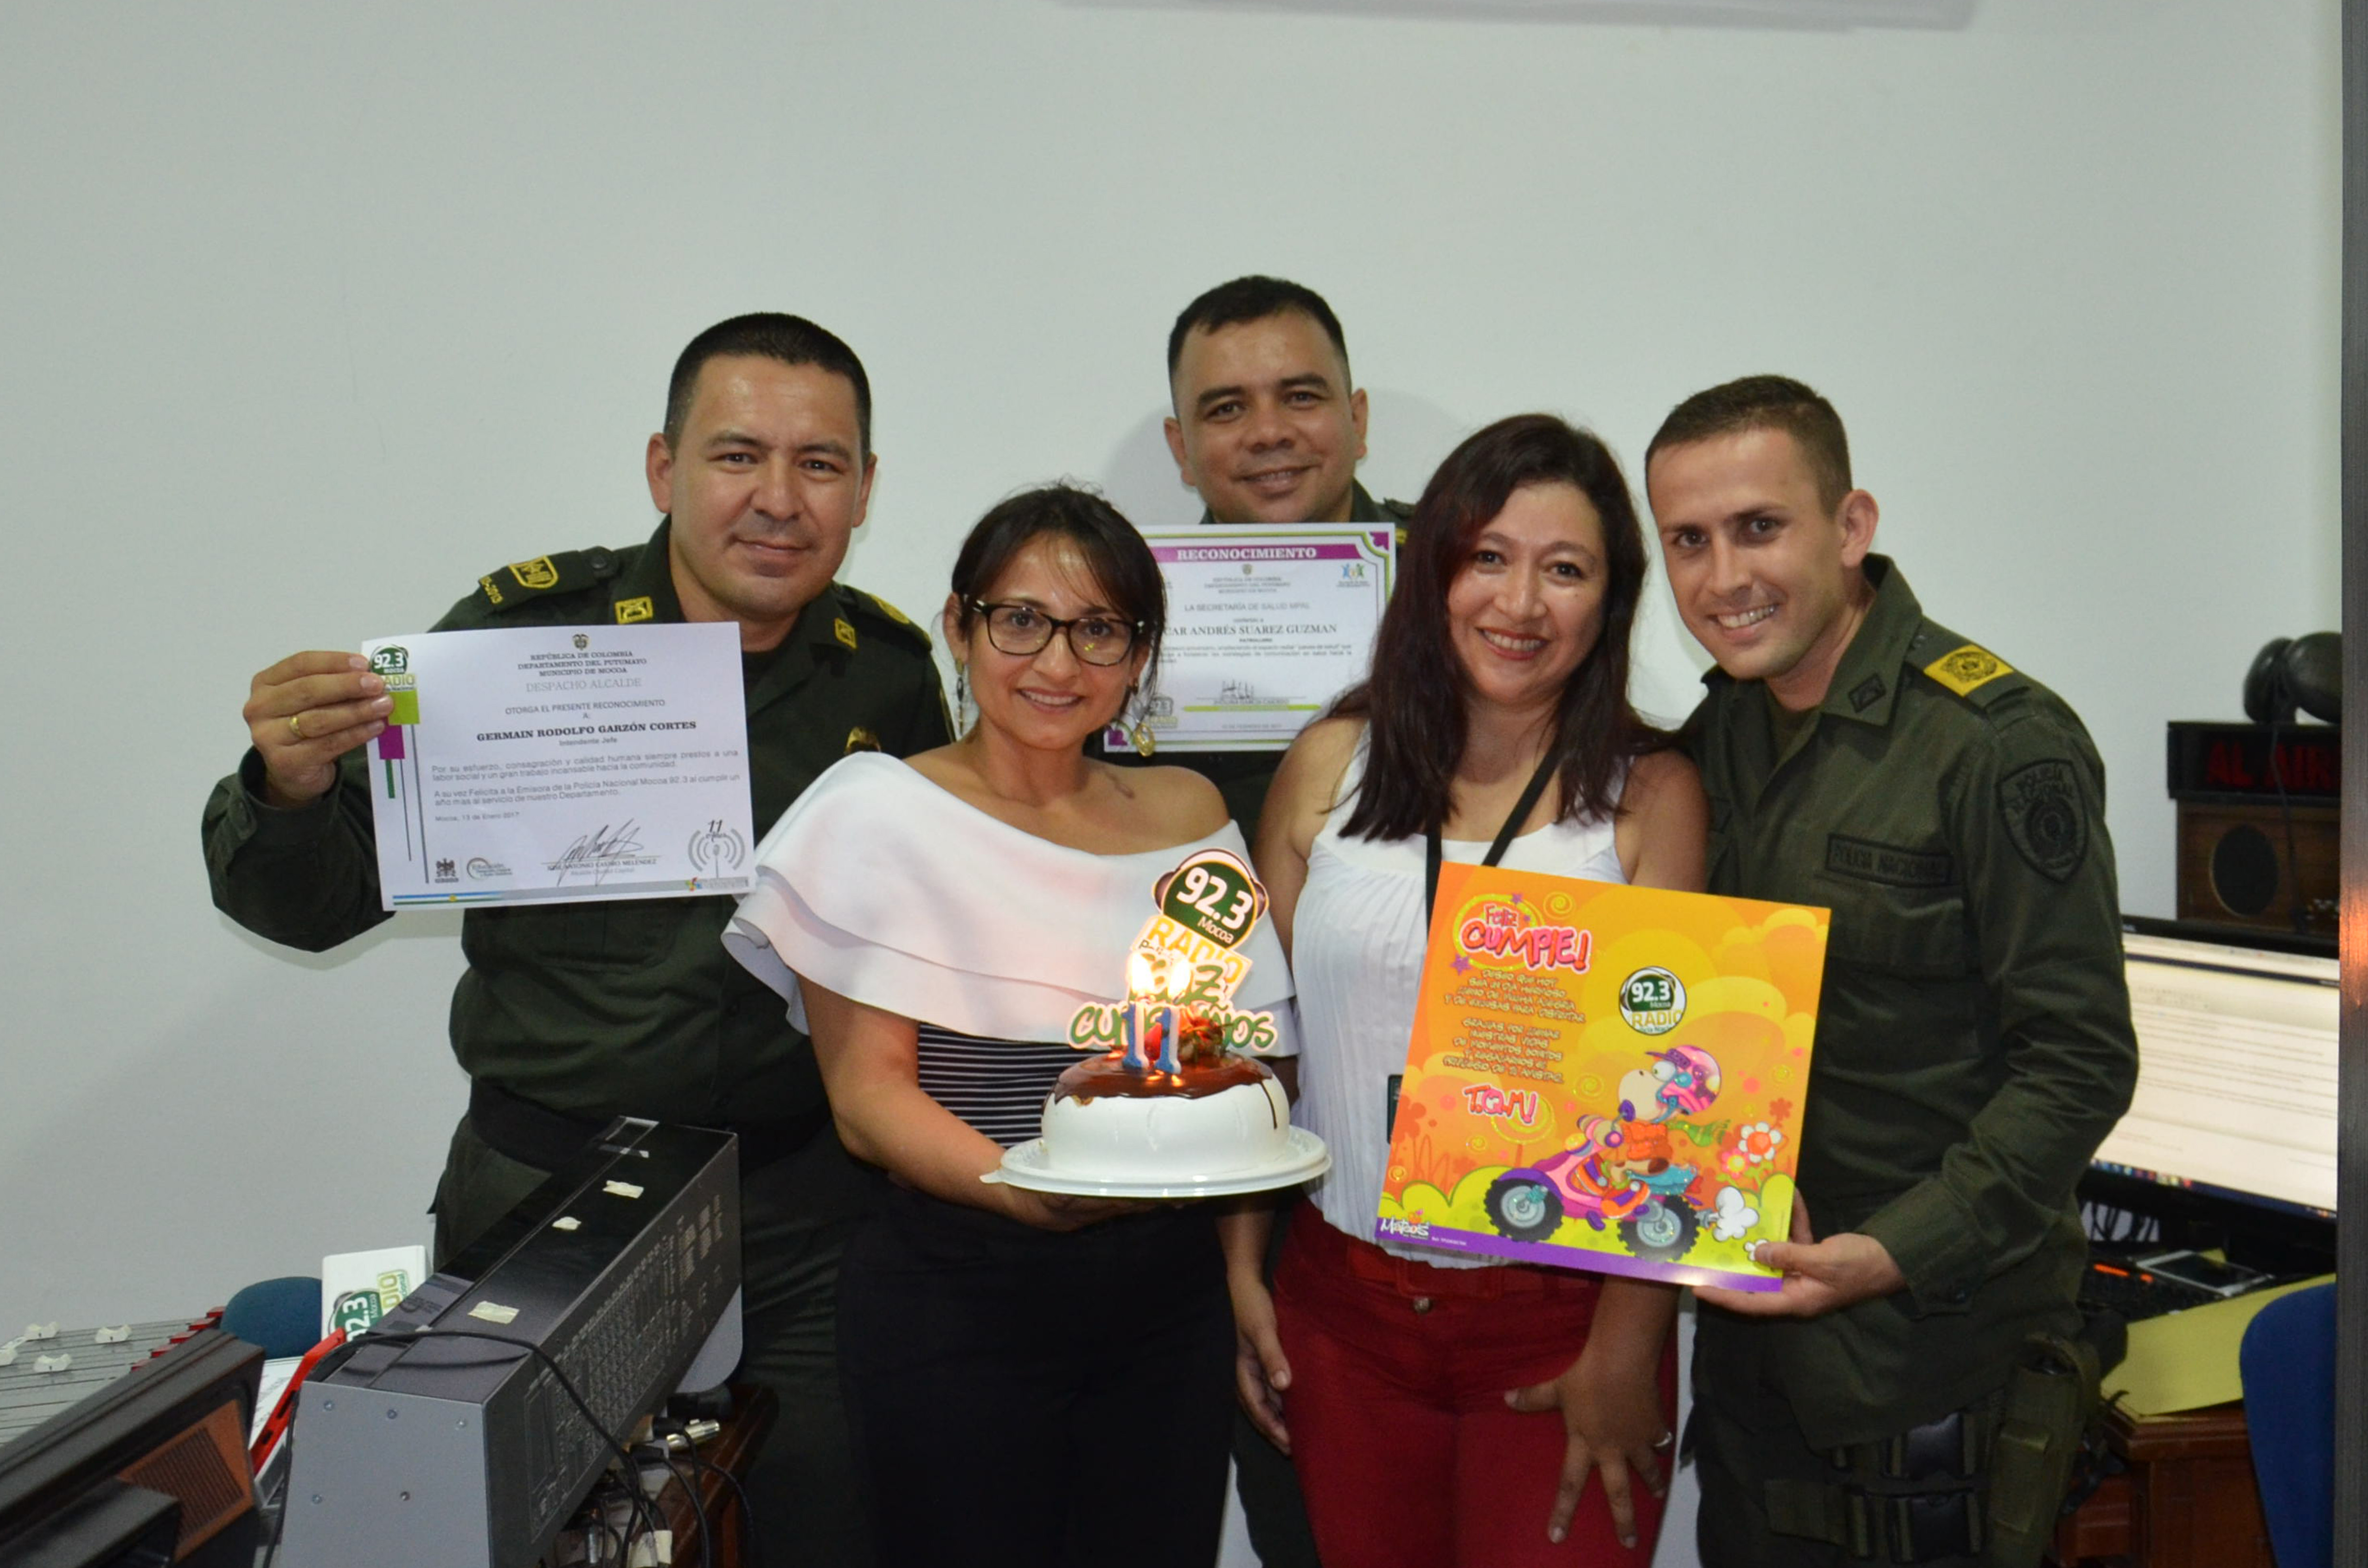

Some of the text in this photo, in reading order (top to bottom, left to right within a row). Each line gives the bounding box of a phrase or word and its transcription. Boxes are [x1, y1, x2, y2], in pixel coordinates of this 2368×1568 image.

[1177, 547, 1317, 561] RECONOCIMIENTO
[1191, 624, 1236, 636] ANDRÉS
[374, 652, 404, 669] 92.3
[530, 652, 575, 661] REPÚBLICA
[518, 661, 583, 670] DEPARTAMENTO
[383, 673, 415, 686] ADIO
[526, 678, 641, 692] DESPACHO ALCALDE
[506, 705, 539, 715] OTORGA
[552, 703, 591, 711] PRESENTE
[593, 699, 666, 709] RECONOCIMIENTO
[477, 721, 697, 742] GERMAIN RODOLFO GARZÓN CORTES
[645, 752, 677, 760] siempre
[500, 771, 518, 779] gran
[520, 768, 549, 777] trabajo
[596, 762, 618, 771] hacia
[2261, 742, 2334, 790] AIR
[469, 787, 499, 796] Felicita
[517, 784, 550, 793] Emisora
[603, 778, 638, 787] Nacional
[640, 777, 667, 785] Mocoa
[698, 774, 728, 783] cumplir
[482, 796, 514, 804] servicio
[527, 793, 557, 801] nuestro
[708, 819, 723, 833] 11
[1176, 867, 1253, 930] 92.3
[1197, 916, 1234, 944] Mocoa
[1631, 980, 1670, 1003] 92.3
[379, 1274, 401, 1309] DIO
[369, 1293, 379, 1319] Mocoa
